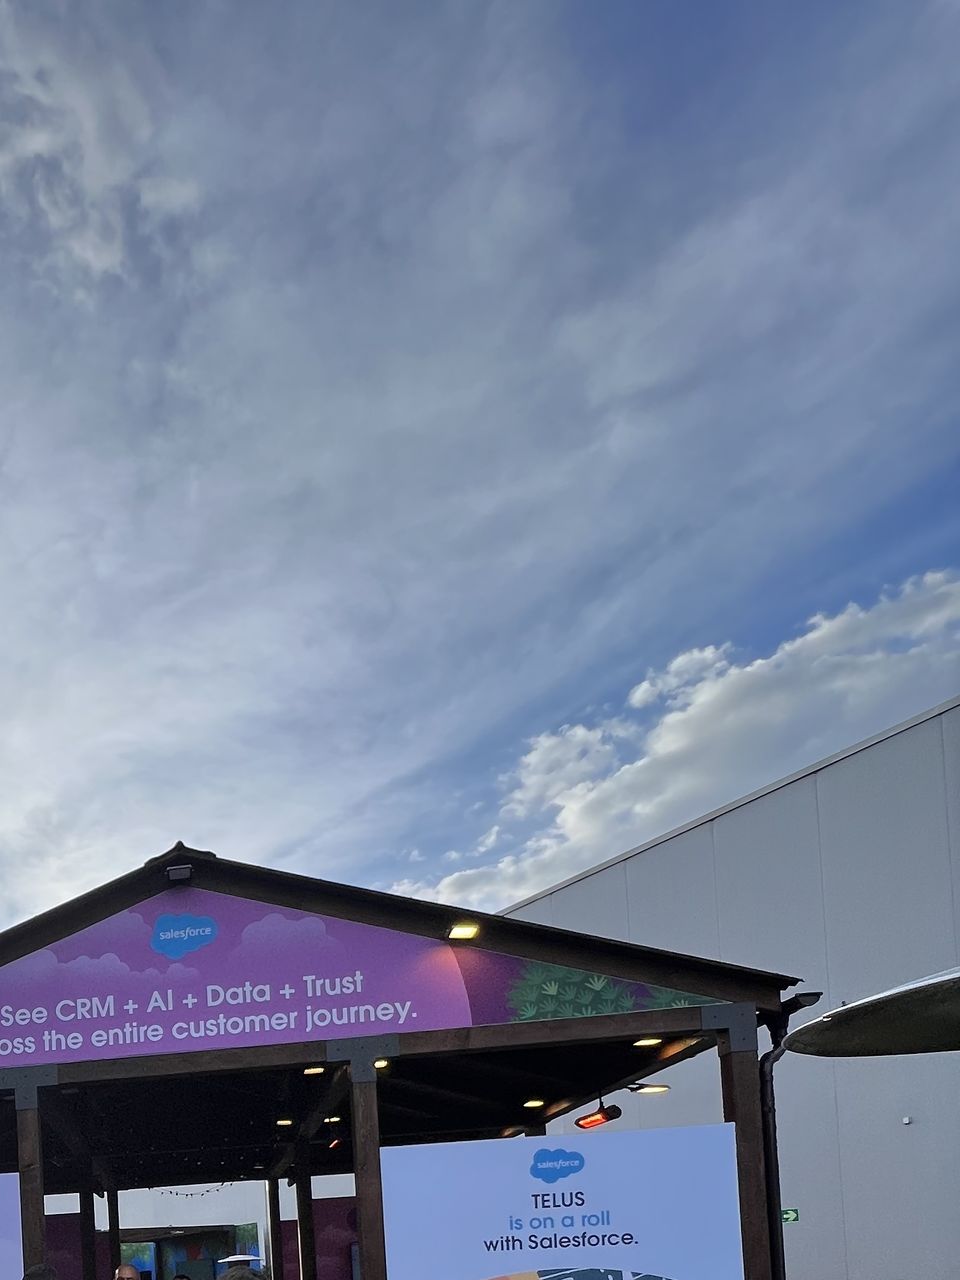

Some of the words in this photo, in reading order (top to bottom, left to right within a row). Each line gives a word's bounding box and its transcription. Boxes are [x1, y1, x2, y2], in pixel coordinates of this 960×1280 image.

[159, 925, 212, 941] salesforce
[0, 1005, 48, 1027] See
[55, 995, 115, 1021] CRM
[123, 999, 138, 1014] +
[146, 989, 173, 1013] AI
[183, 994, 197, 1009] +
[206, 981, 271, 1007] Data
[280, 984, 295, 999] +
[303, 970, 364, 997] Trust
[43, 1030, 83, 1051] the
[91, 1022, 164, 1047] entire
[171, 1010, 298, 1039] customer
[305, 1001, 417, 1032] journey.
[537, 1159, 580, 1170] salesforce
[531, 1191, 585, 1209] TELUS
[509, 1216, 524, 1231] is
[529, 1217, 555, 1230] on
[561, 1215, 575, 1228] a
[582, 1210, 611, 1227] roll
[483, 1236, 523, 1252] with
[528, 1231, 639, 1250] Salesforce.
